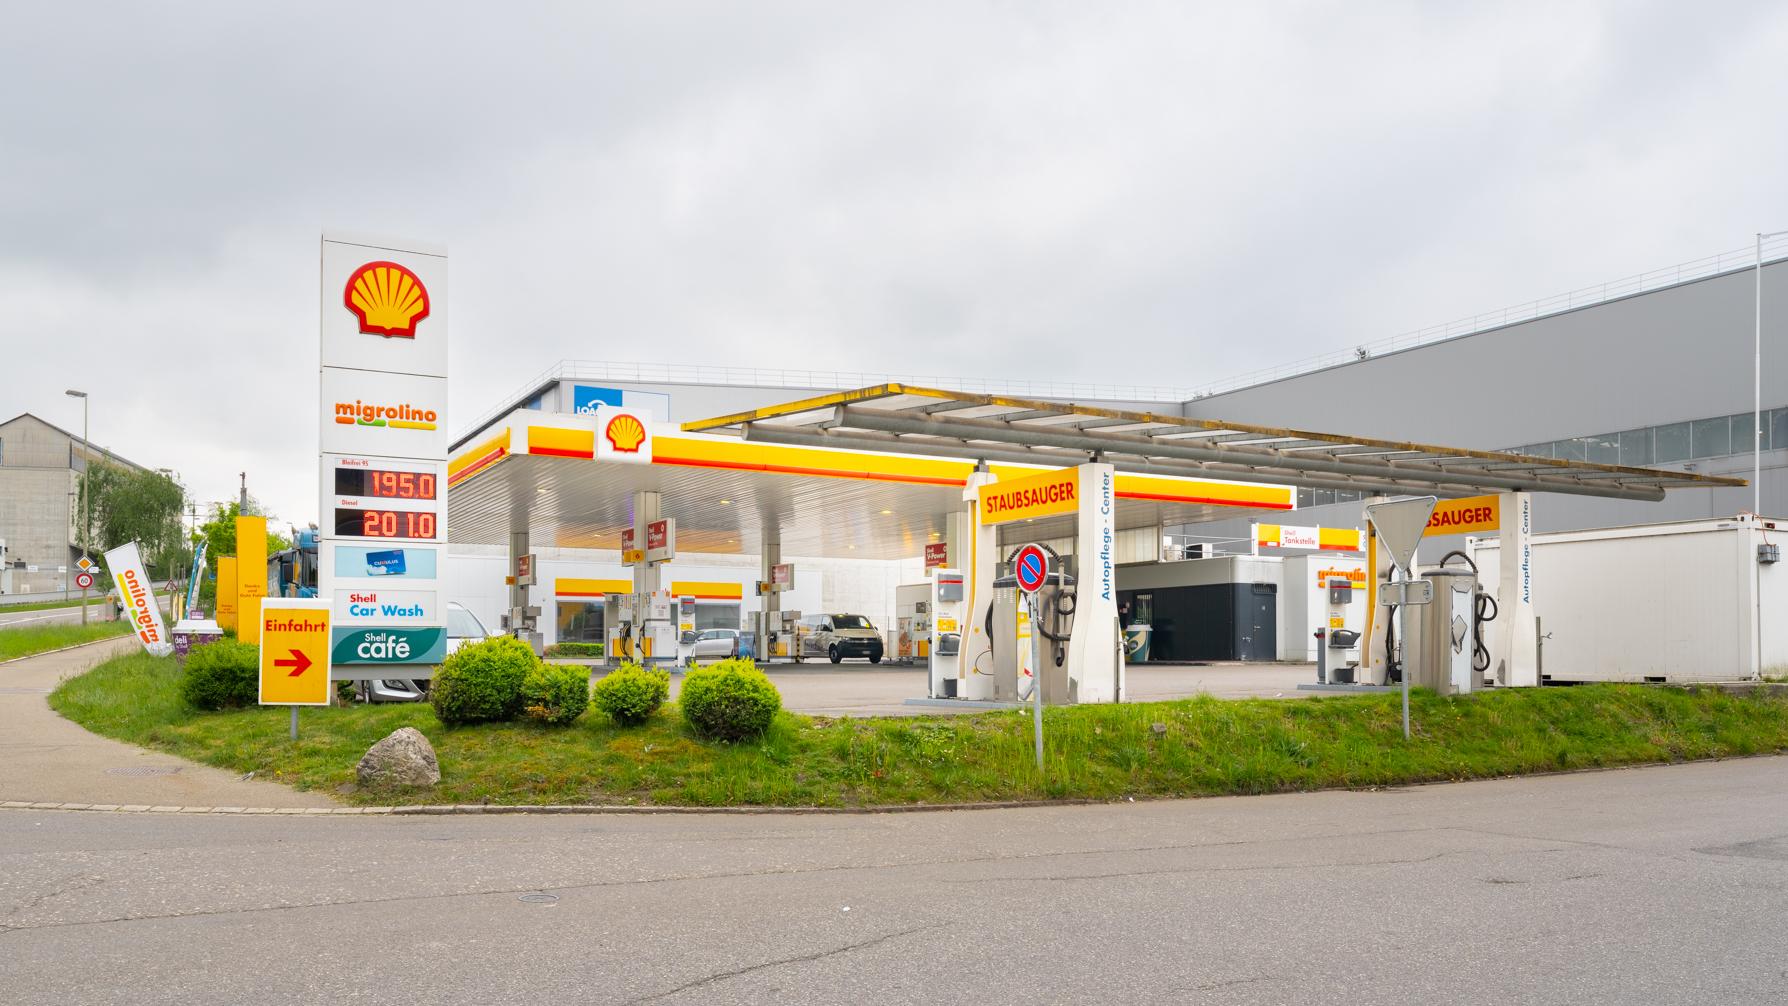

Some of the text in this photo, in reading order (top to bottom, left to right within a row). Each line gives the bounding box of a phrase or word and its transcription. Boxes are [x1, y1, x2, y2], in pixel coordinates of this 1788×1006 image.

[335, 400, 437, 424] migrolino
[341, 458, 361, 466] Bleifrei
[987, 481, 1075, 514] STAUBSAUGER
[1101, 472, 1110, 516] Center
[1284, 536, 1316, 546] Tankstelle
[1101, 526, 1113, 601] Autopflege
[1522, 544, 1530, 604] Autopflege
[350, 593, 377, 603] Shell
[349, 604, 424, 618] Car Wash
[265, 618, 326, 632] Einfahrt
[174, 635, 188, 644] deli
[364, 632, 387, 643] Shell
[357, 635, 411, 660] café
